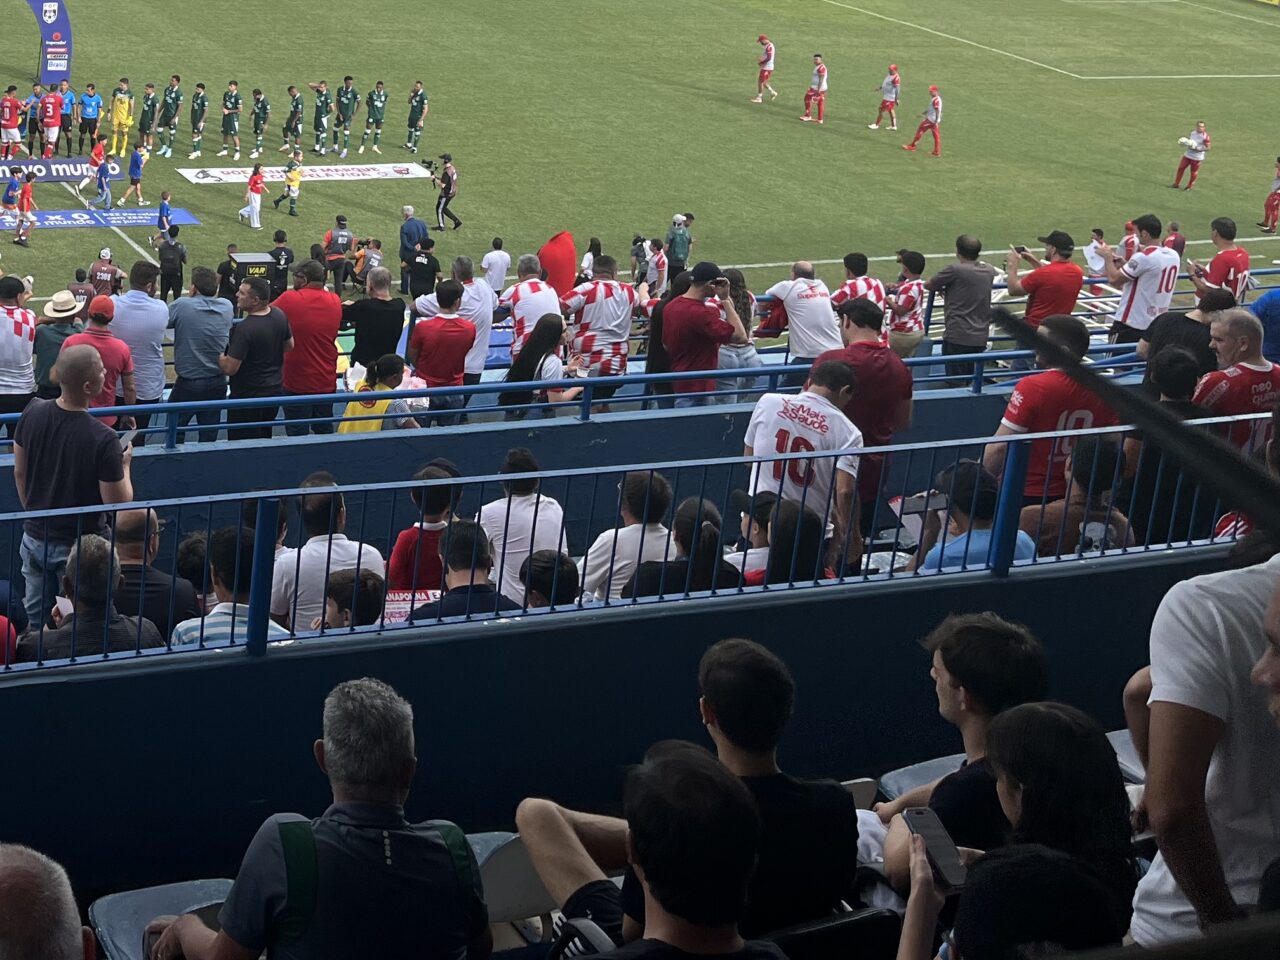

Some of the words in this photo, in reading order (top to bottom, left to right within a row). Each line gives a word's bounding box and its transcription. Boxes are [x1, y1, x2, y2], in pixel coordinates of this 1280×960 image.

[45, 103, 54, 116] 3
[44, 218, 96, 226] mundo
[1156, 264, 1178, 294] 10
[798, 404, 827, 423] Mais
[1053, 409, 1094, 455] 10
